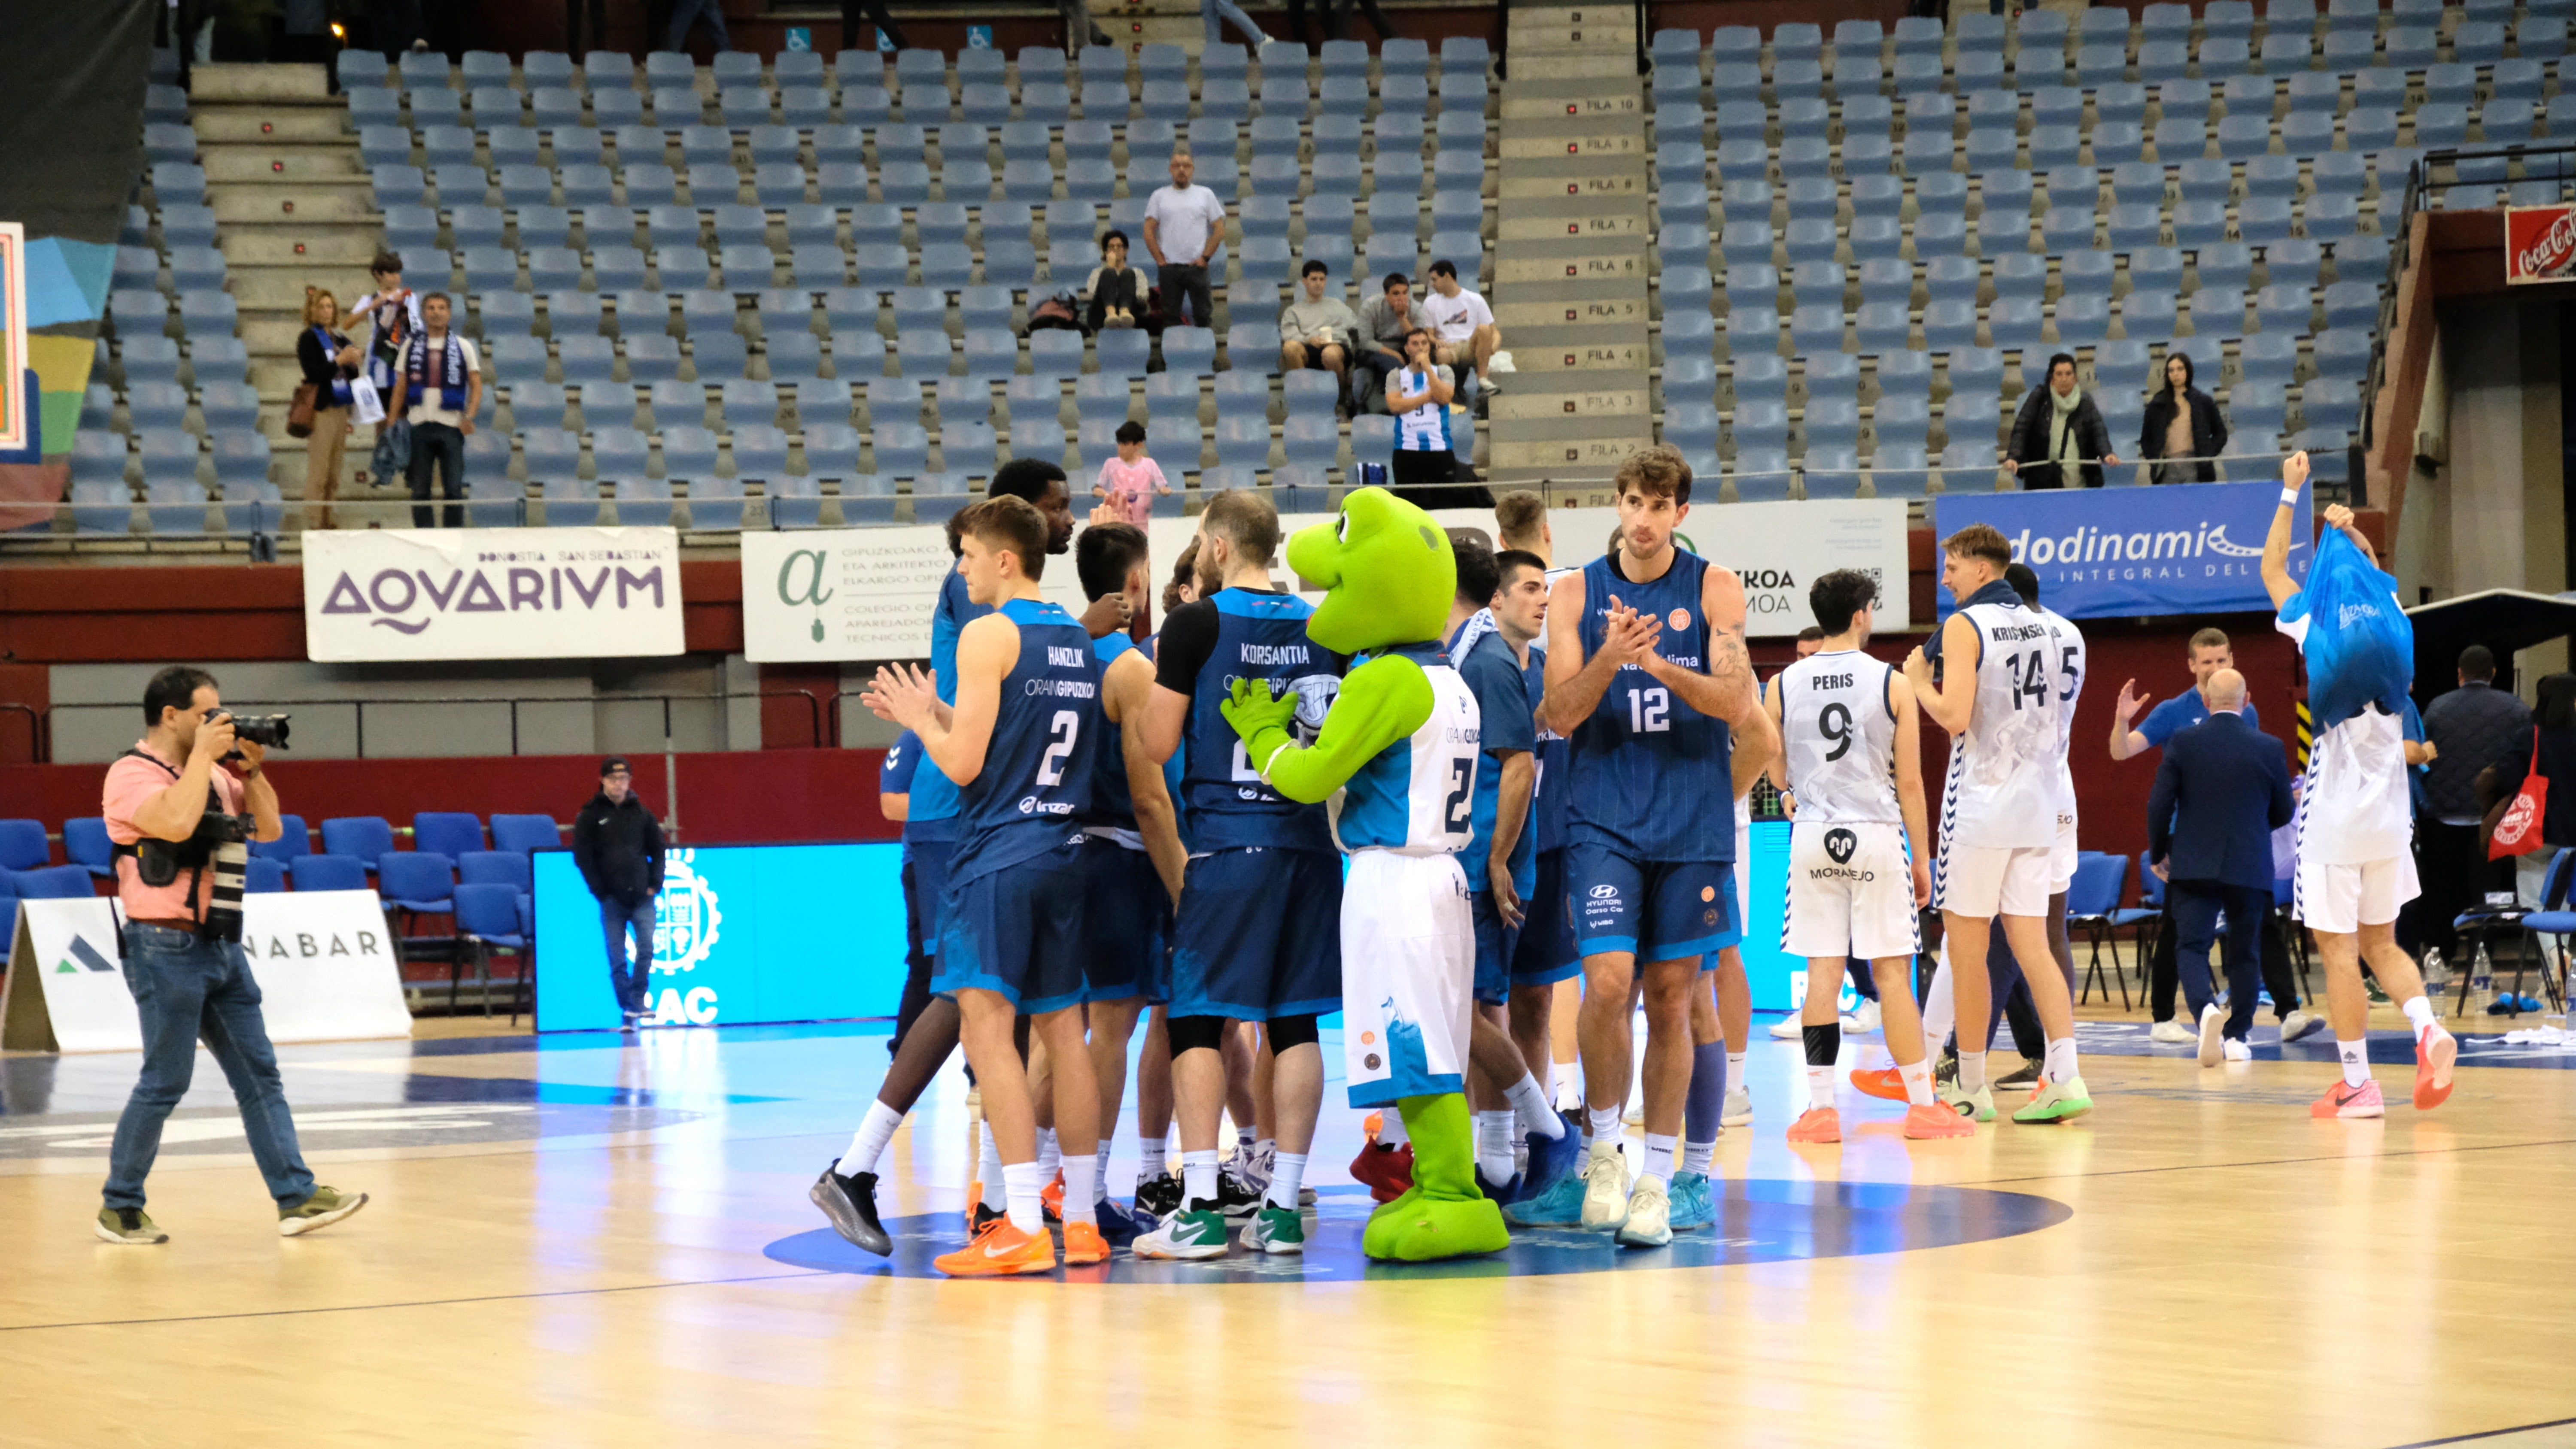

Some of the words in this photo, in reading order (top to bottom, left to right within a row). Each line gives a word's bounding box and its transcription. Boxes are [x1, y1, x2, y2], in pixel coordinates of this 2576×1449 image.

[1587, 100, 1611, 110] FILA
[1620, 100, 1633, 109] 10
[1587, 139, 1612, 149] FILA
[1622, 138, 1628, 148] 9
[1590, 180, 1614, 190] FILA
[1590, 220, 1615, 230] FILA
[1626, 220, 1632, 229] 7
[1589, 261, 1614, 271] FILA
[1589, 305, 1615, 315] FILA
[1626, 304, 1632, 314] 5
[1588, 351, 1614, 361] FILA
[1625, 350, 1631, 360] 4
[1587, 397, 1615, 407] FILA
[1625, 396, 1632, 406] 3
[1590, 445, 1618, 455] FILA
[1628, 444, 1635, 454] 2
[478, 551, 546, 562] DONOSTIA
[559, 550, 585, 561] SAN
[589, 550, 661, 561] SEBASTIAN
[842, 546, 938, 557] GIPUZKOAKO
[843, 561, 866, 571] ETA
[872, 559, 946, 570] ARKITEKTO
[2060, 566, 2185, 582] INTEGRAL
[2205, 564, 2247, 577] DEL
[844, 576, 909, 585] ELKARGO
[844, 605, 910, 614] COLEGIO
[847, 633, 919, 643] TECNICOS
[1048, 646, 1085, 667] HANZLIK
[1241, 643, 1310, 664] KORSANTIA
[1813, 673, 1854, 690] PERIS
[2006, 650, 2047, 711] 14
[1627, 687, 1670, 733] 12
[1819, 703, 1853, 762] 9
[1036, 710, 1079, 786] 2
[1586, 899, 1622, 907] HYUNDAI
